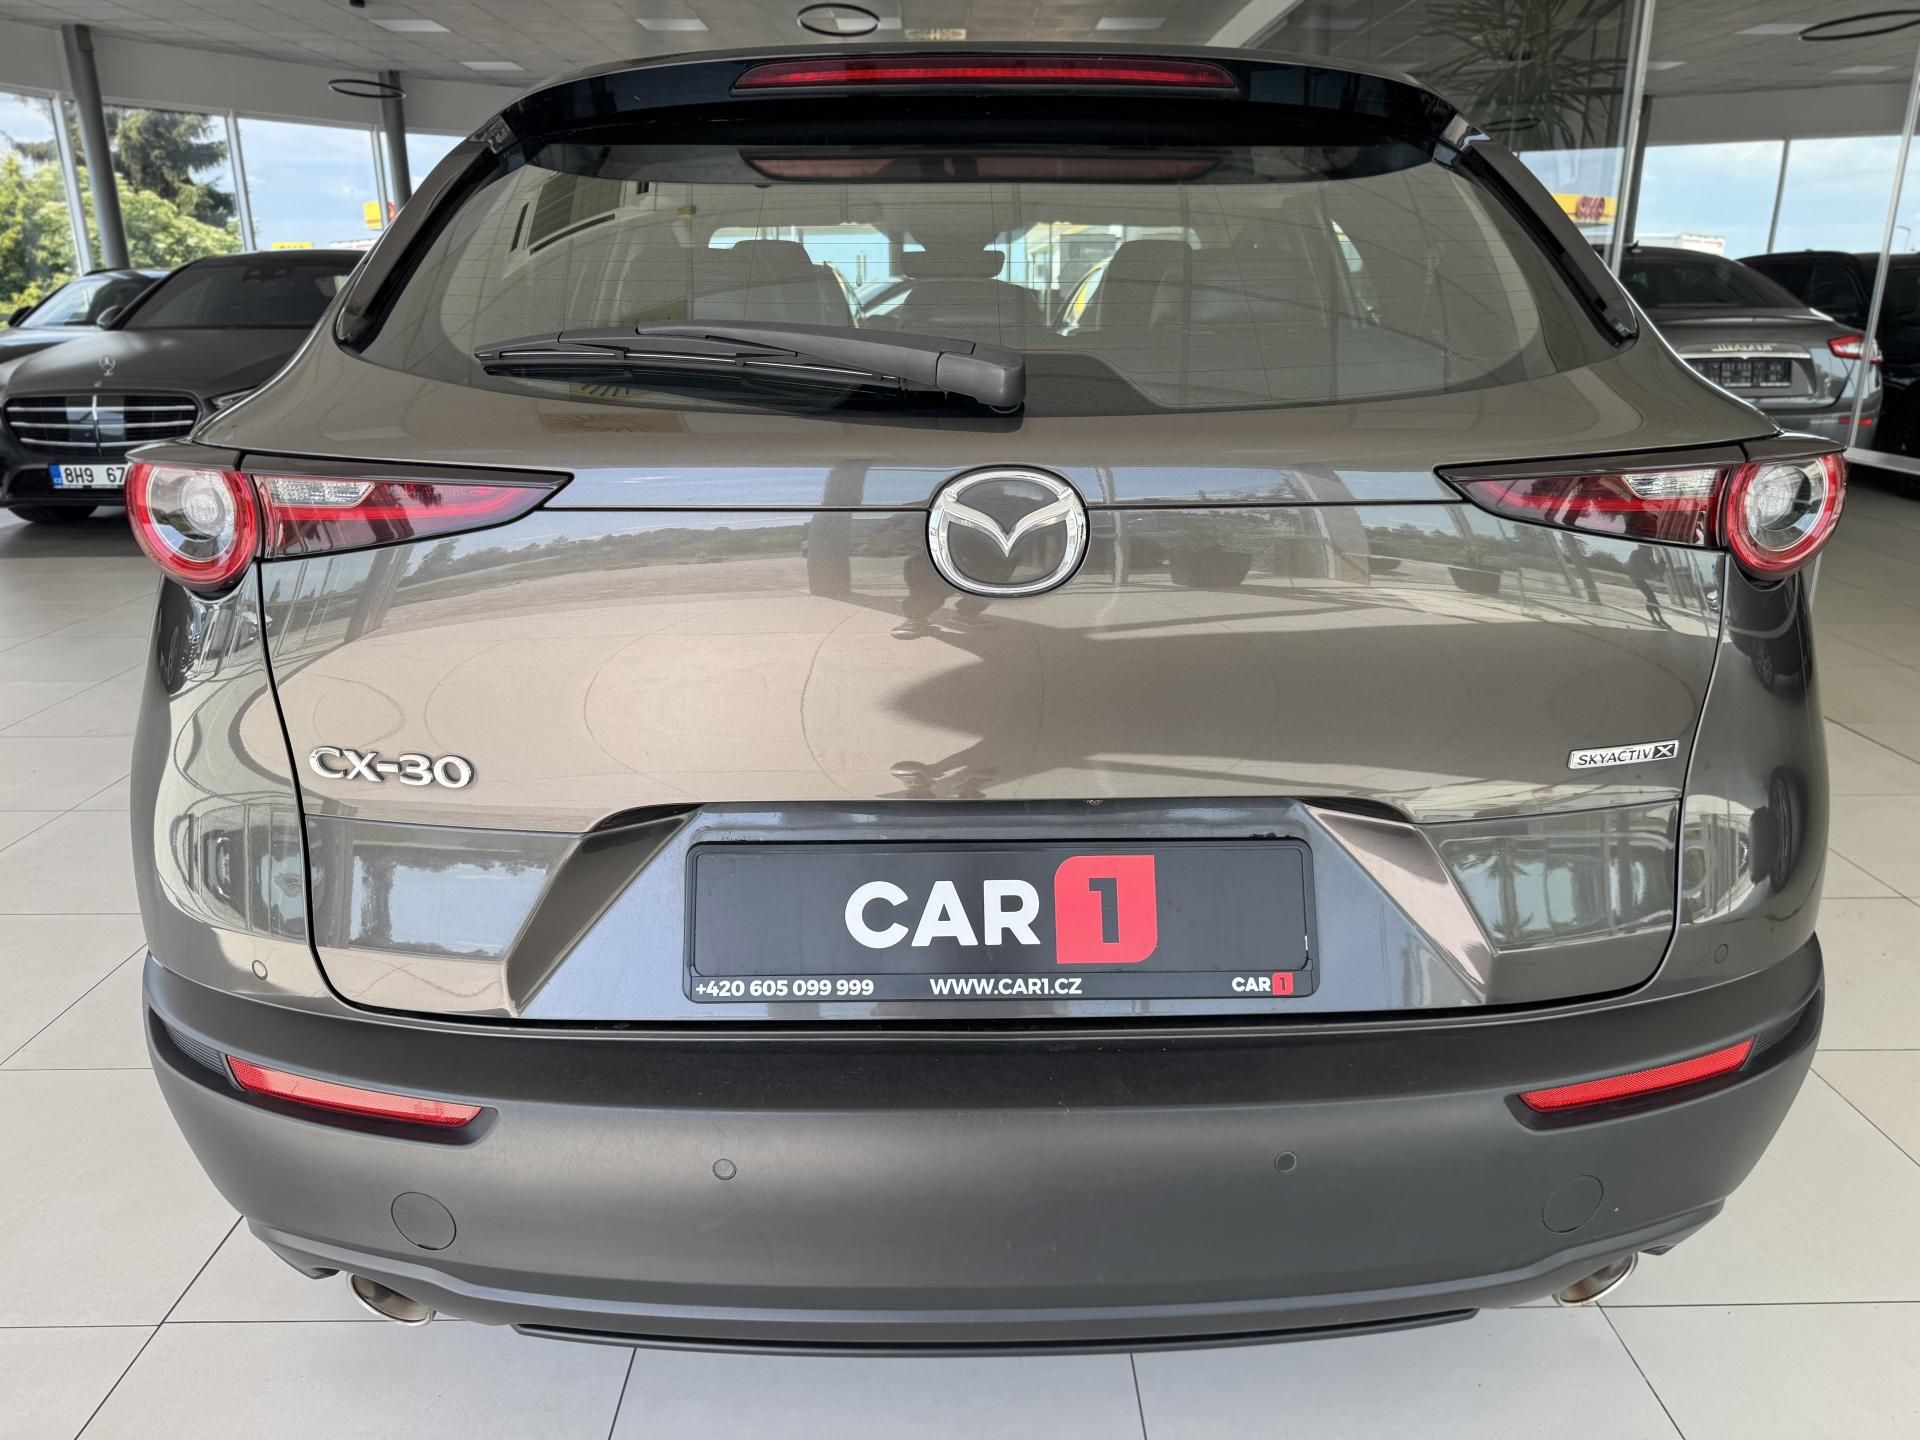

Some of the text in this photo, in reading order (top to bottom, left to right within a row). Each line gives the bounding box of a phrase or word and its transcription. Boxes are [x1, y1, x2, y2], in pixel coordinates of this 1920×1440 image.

[64, 467, 94, 483] 8H9
[309, 745, 475, 789] CX-30
[845, 880, 1041, 949] CAR
[695, 979, 875, 997] +420 605 099 999
[929, 978, 1083, 995] WWW.CAR1.CZ
[1231, 976, 1271, 992] CAR
